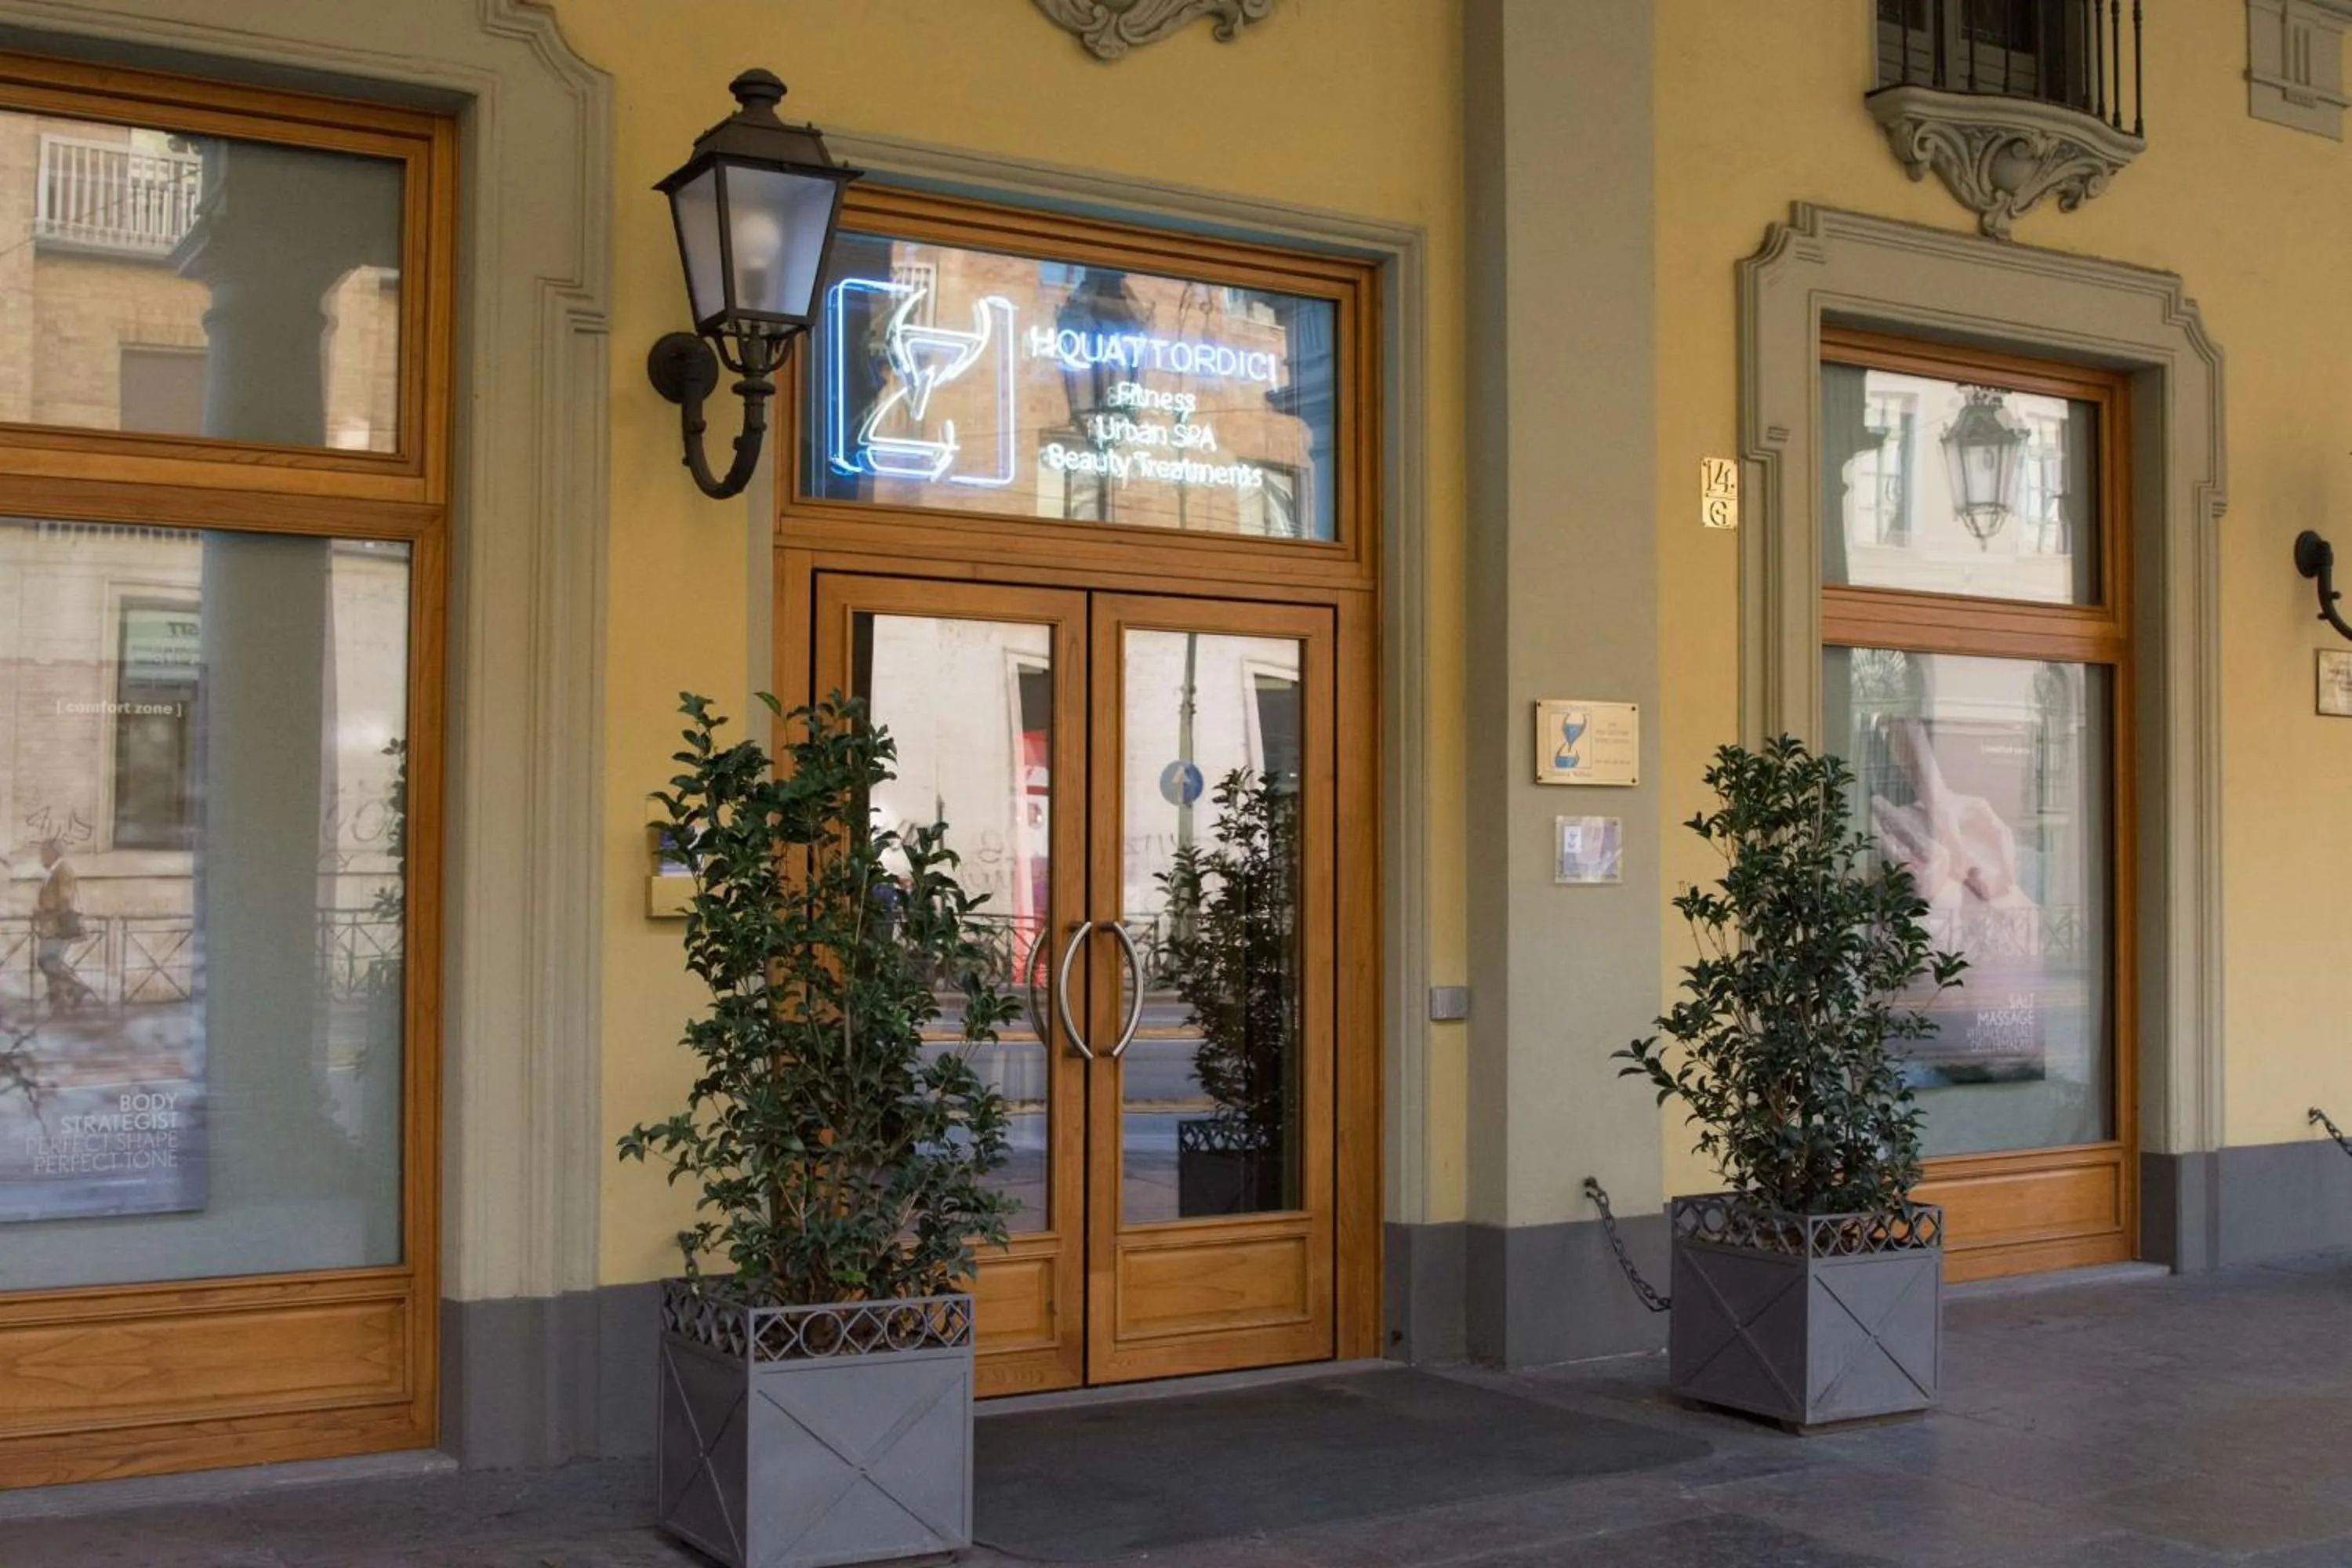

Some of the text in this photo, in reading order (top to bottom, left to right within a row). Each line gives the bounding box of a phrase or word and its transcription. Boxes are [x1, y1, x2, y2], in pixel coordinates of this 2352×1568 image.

[1113, 382, 1196, 412] Fitness
[1094, 415, 1217, 452] Urban SPA
[1046, 442, 1263, 488] Beauty Treatments
[134, 703, 174, 714] zone
[1977, 1010, 2034, 1026] MASSAGE
[120, 1093, 178, 1112] BODY
[61, 1112, 179, 1134] STRATEGIST
[26, 1131, 177, 1156] PERFECT SHAPE
[34, 1150, 177, 1175] PERFECT TONE
